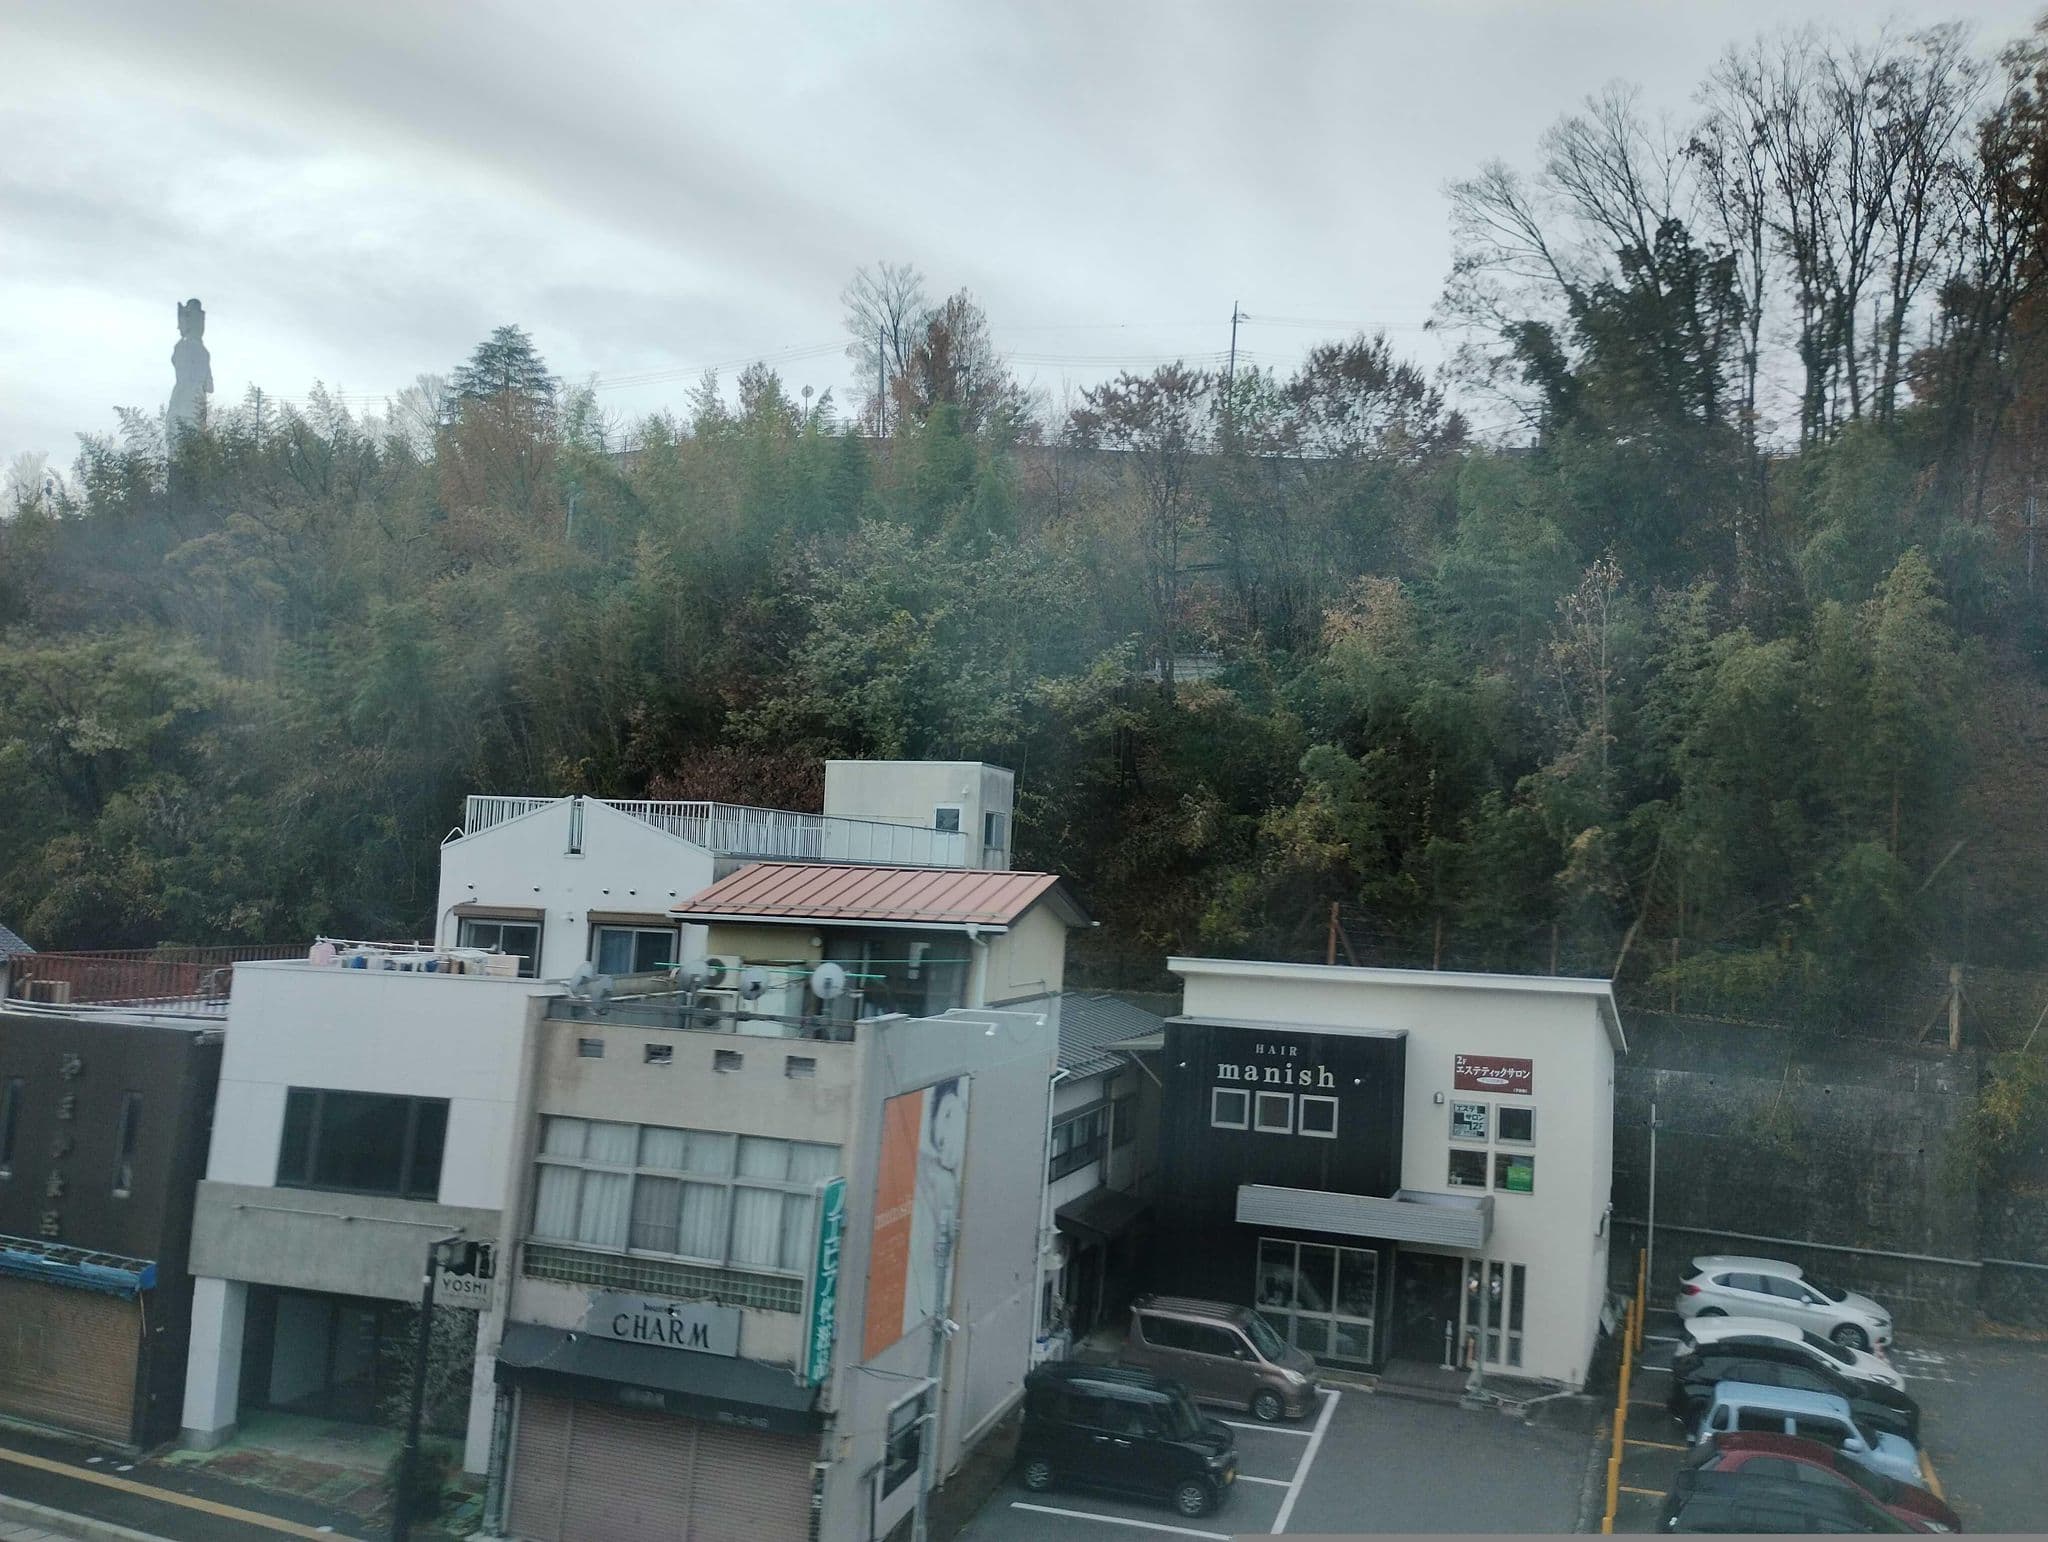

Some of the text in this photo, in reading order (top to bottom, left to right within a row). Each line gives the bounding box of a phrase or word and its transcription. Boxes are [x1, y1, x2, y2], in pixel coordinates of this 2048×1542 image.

[1255, 1043, 1298, 1057] HAIR
[1456, 1056, 1467, 1065] 2F
[1216, 1062, 1336, 1089] manish
[1456, 1066, 1530, 1079] エステティックサロン
[442, 1278, 487, 1295] YOSHI
[612, 1312, 711, 1349] CHARM
